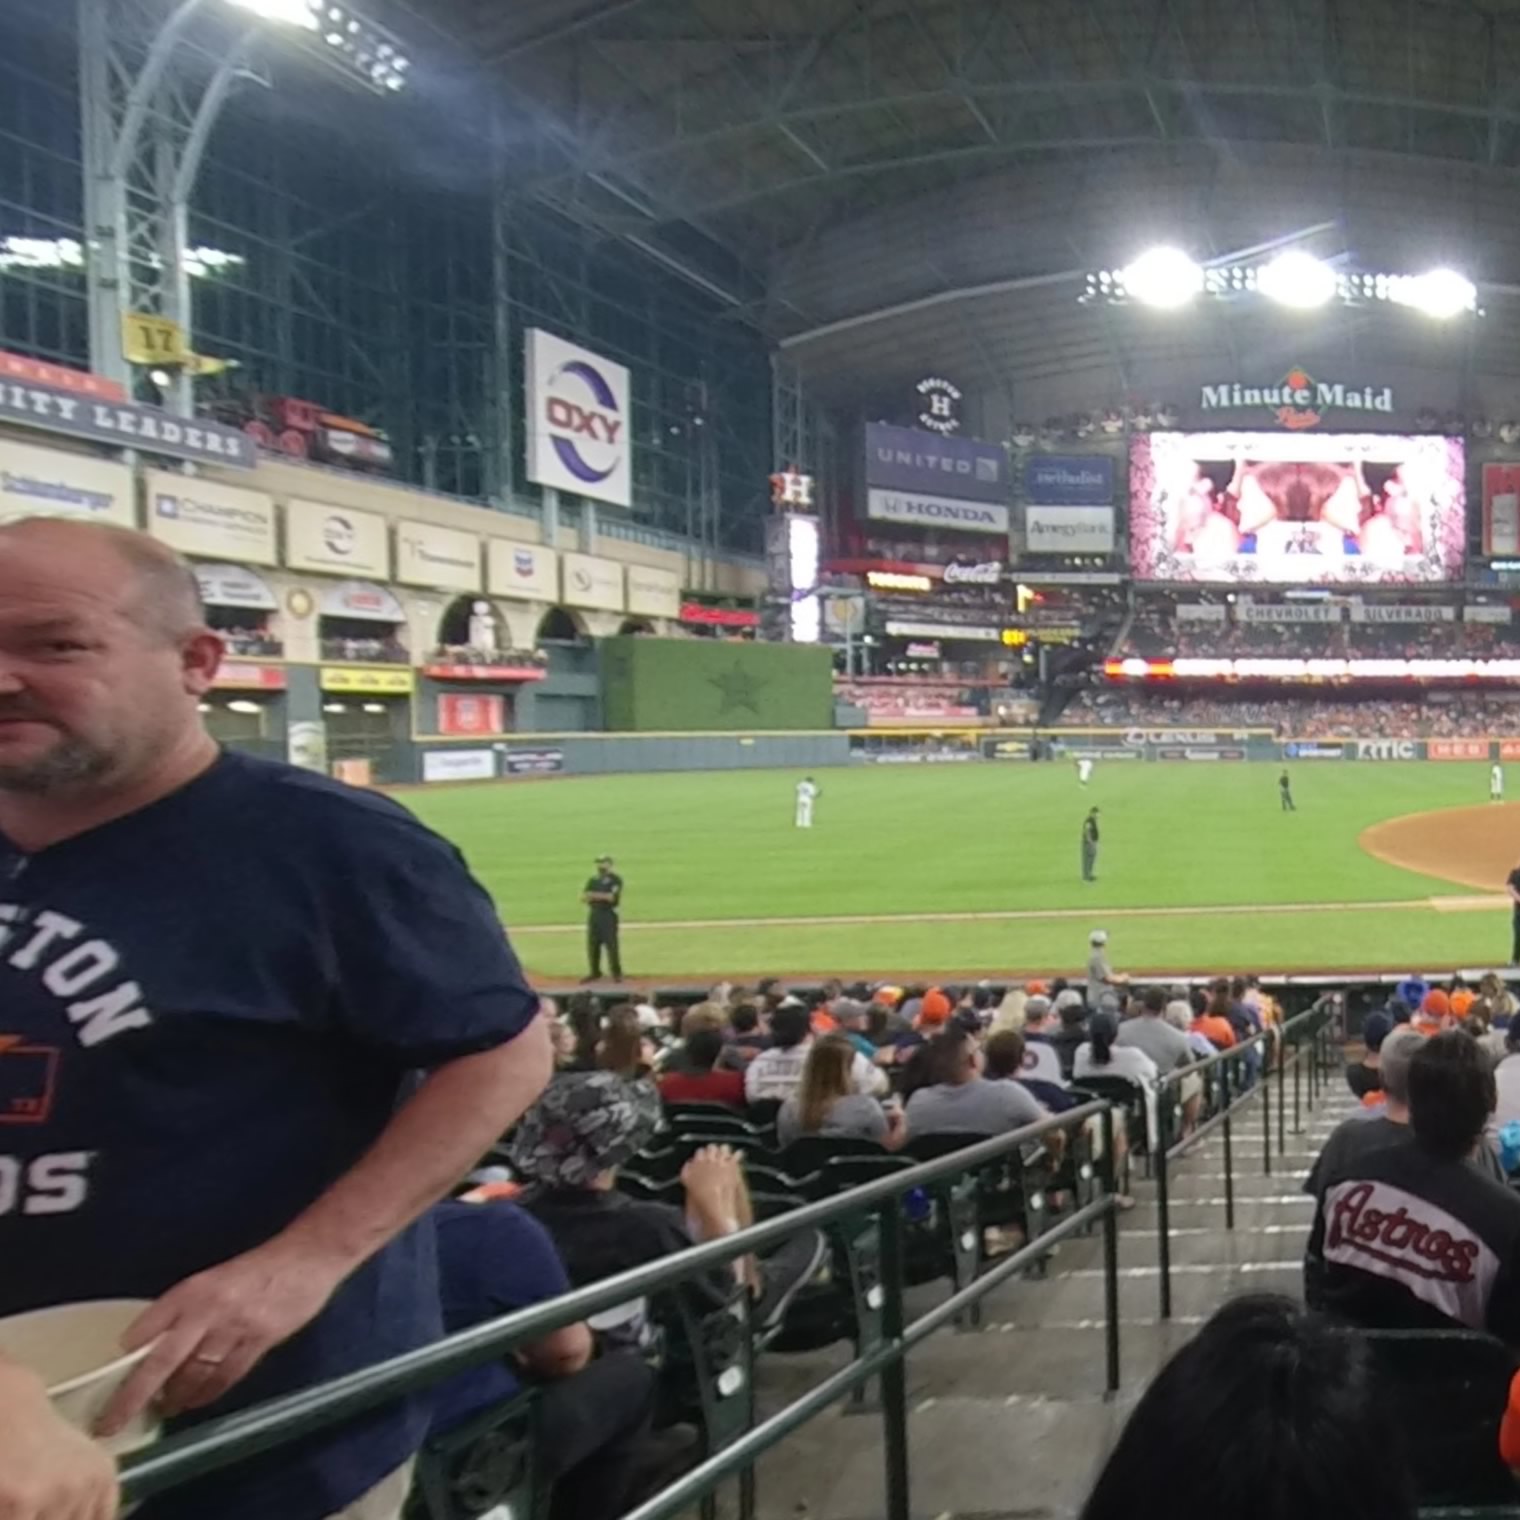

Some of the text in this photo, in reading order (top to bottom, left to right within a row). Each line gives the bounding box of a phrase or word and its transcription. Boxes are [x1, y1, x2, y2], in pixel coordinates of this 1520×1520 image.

[139, 326, 173, 352] 17
[930, 394, 951, 416] H
[1201, 382, 1395, 412] Minute Maid
[0, 383, 241, 456] ITY LEADERS
[546, 396, 622, 445] OXY
[877, 447, 971, 474] UNITED
[905, 501, 996, 524] HONDA
[1246, 606, 1443, 621] CHEVROLET SILVERADO
[1328, 1183, 1480, 1284] Astros
